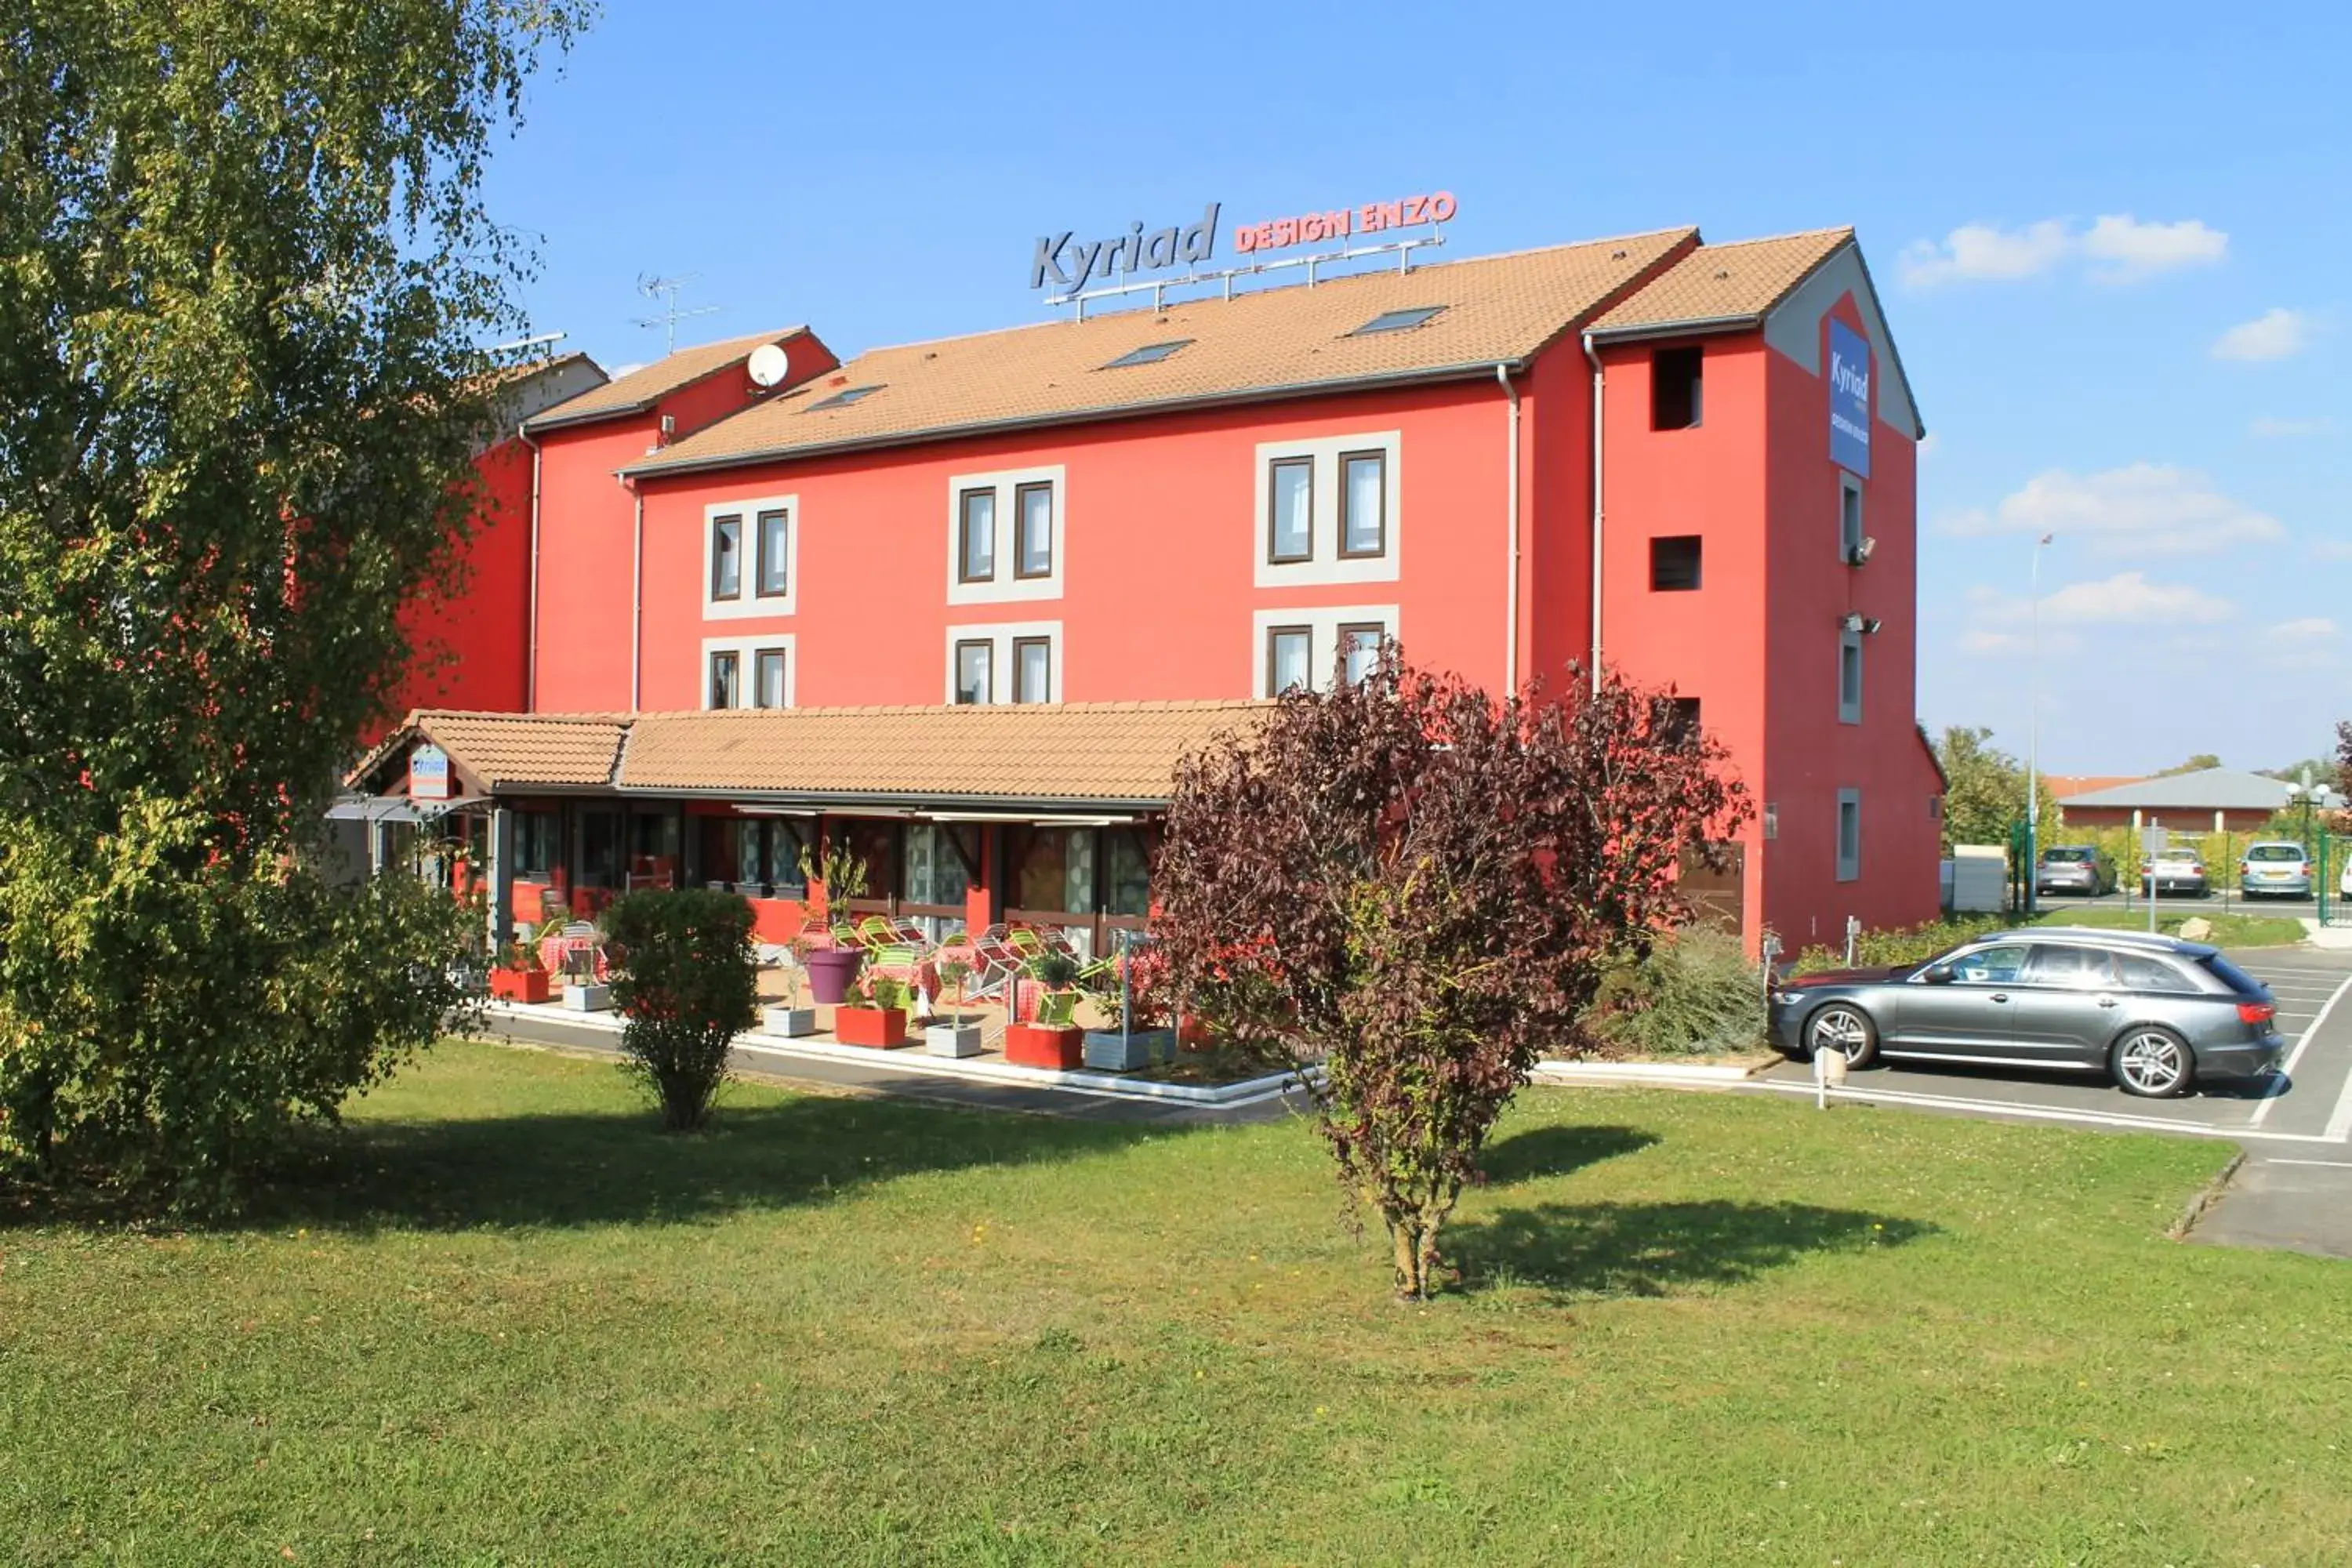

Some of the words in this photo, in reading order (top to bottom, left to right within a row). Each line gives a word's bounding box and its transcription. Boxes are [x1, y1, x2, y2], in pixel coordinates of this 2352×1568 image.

[1030, 202, 1221, 294] Kyriad
[1235, 209, 1350, 253] DESIGN
[1360, 191, 1457, 232] ENZO
[1831, 350, 1868, 401] Kyriad
